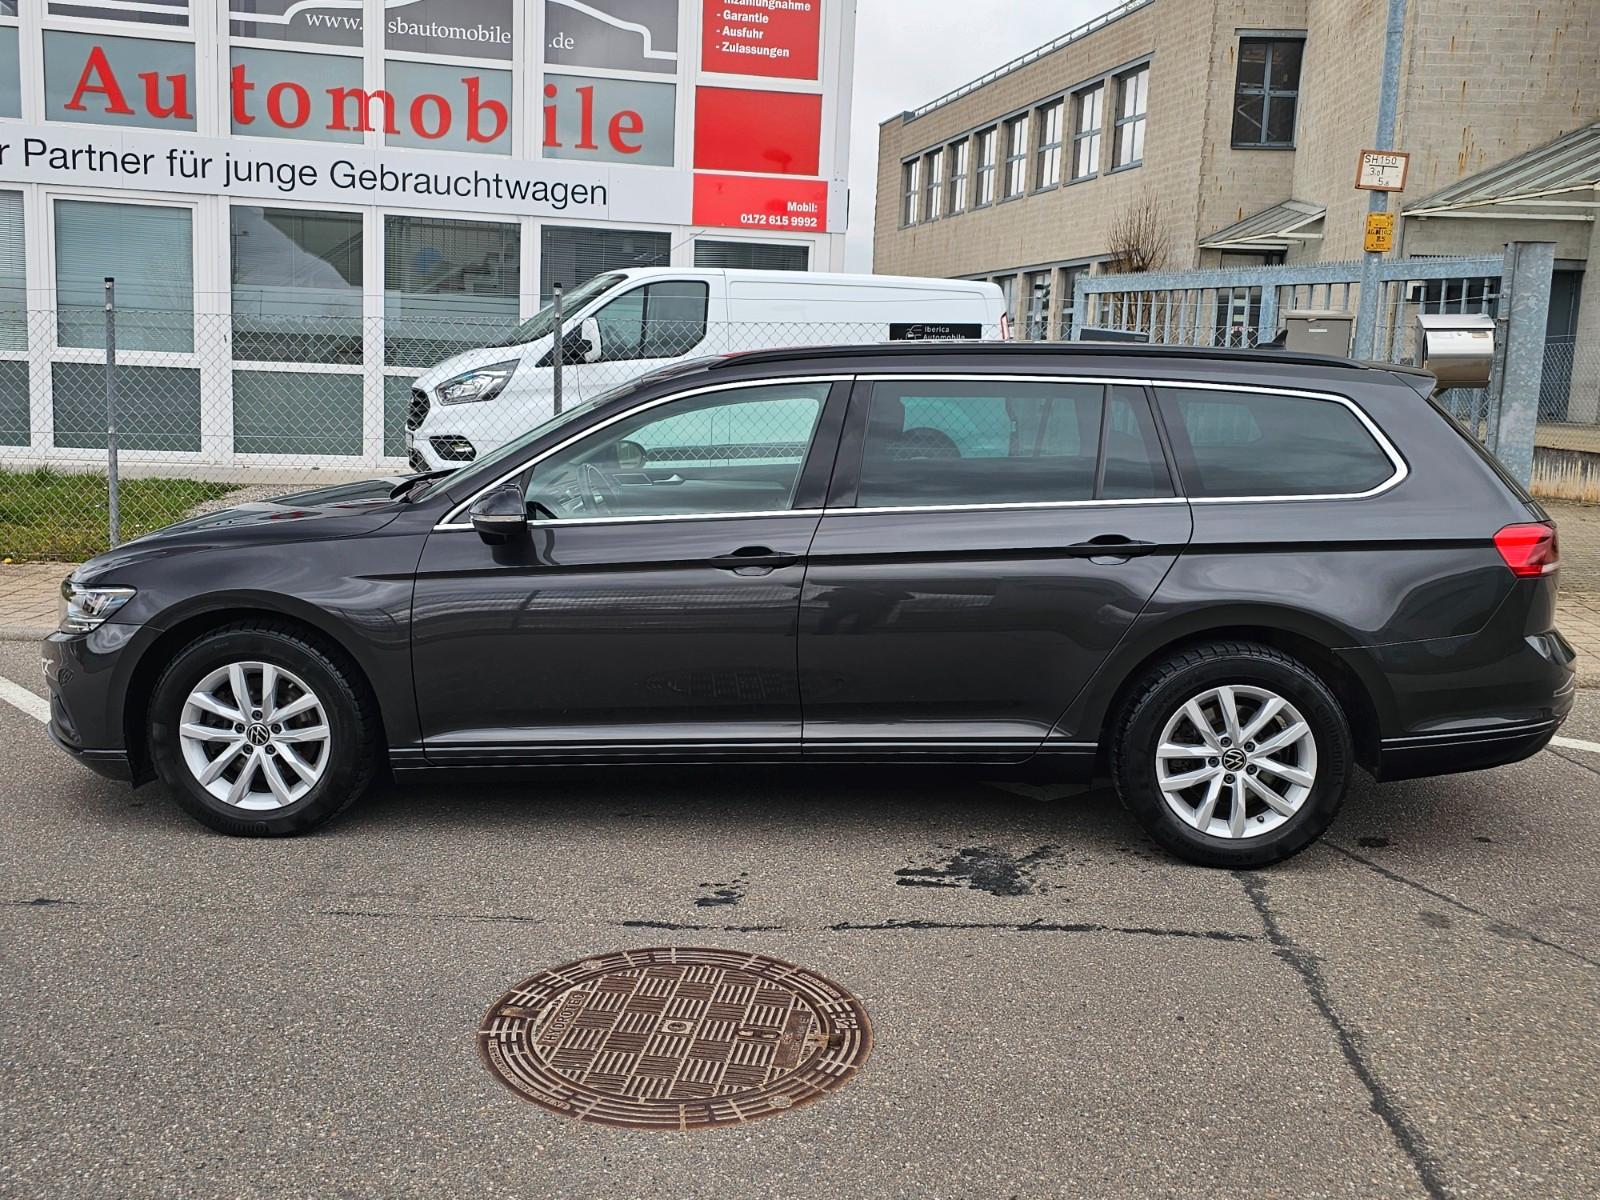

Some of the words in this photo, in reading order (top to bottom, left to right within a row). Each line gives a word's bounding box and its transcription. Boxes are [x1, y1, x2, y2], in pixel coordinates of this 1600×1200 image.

[723, 9, 769, 24] Garantie
[722, 25, 764, 39] Ausfuhr
[721, 41, 790, 58] Zulassungen
[24, 138, 155, 176] Partner
[167, 149, 213, 180] für
[224, 153, 318, 193] junge
[330, 160, 608, 210] Gebrauchtwagen
[787, 201, 818, 213] Mobil:
[741, 213, 766, 225] 0172
[769, 215, 788, 226] 615
[791, 217, 817, 227] 9992
[924, 325, 950, 333] Iberica
[543, 993, 586, 1041] HYDROTEC
